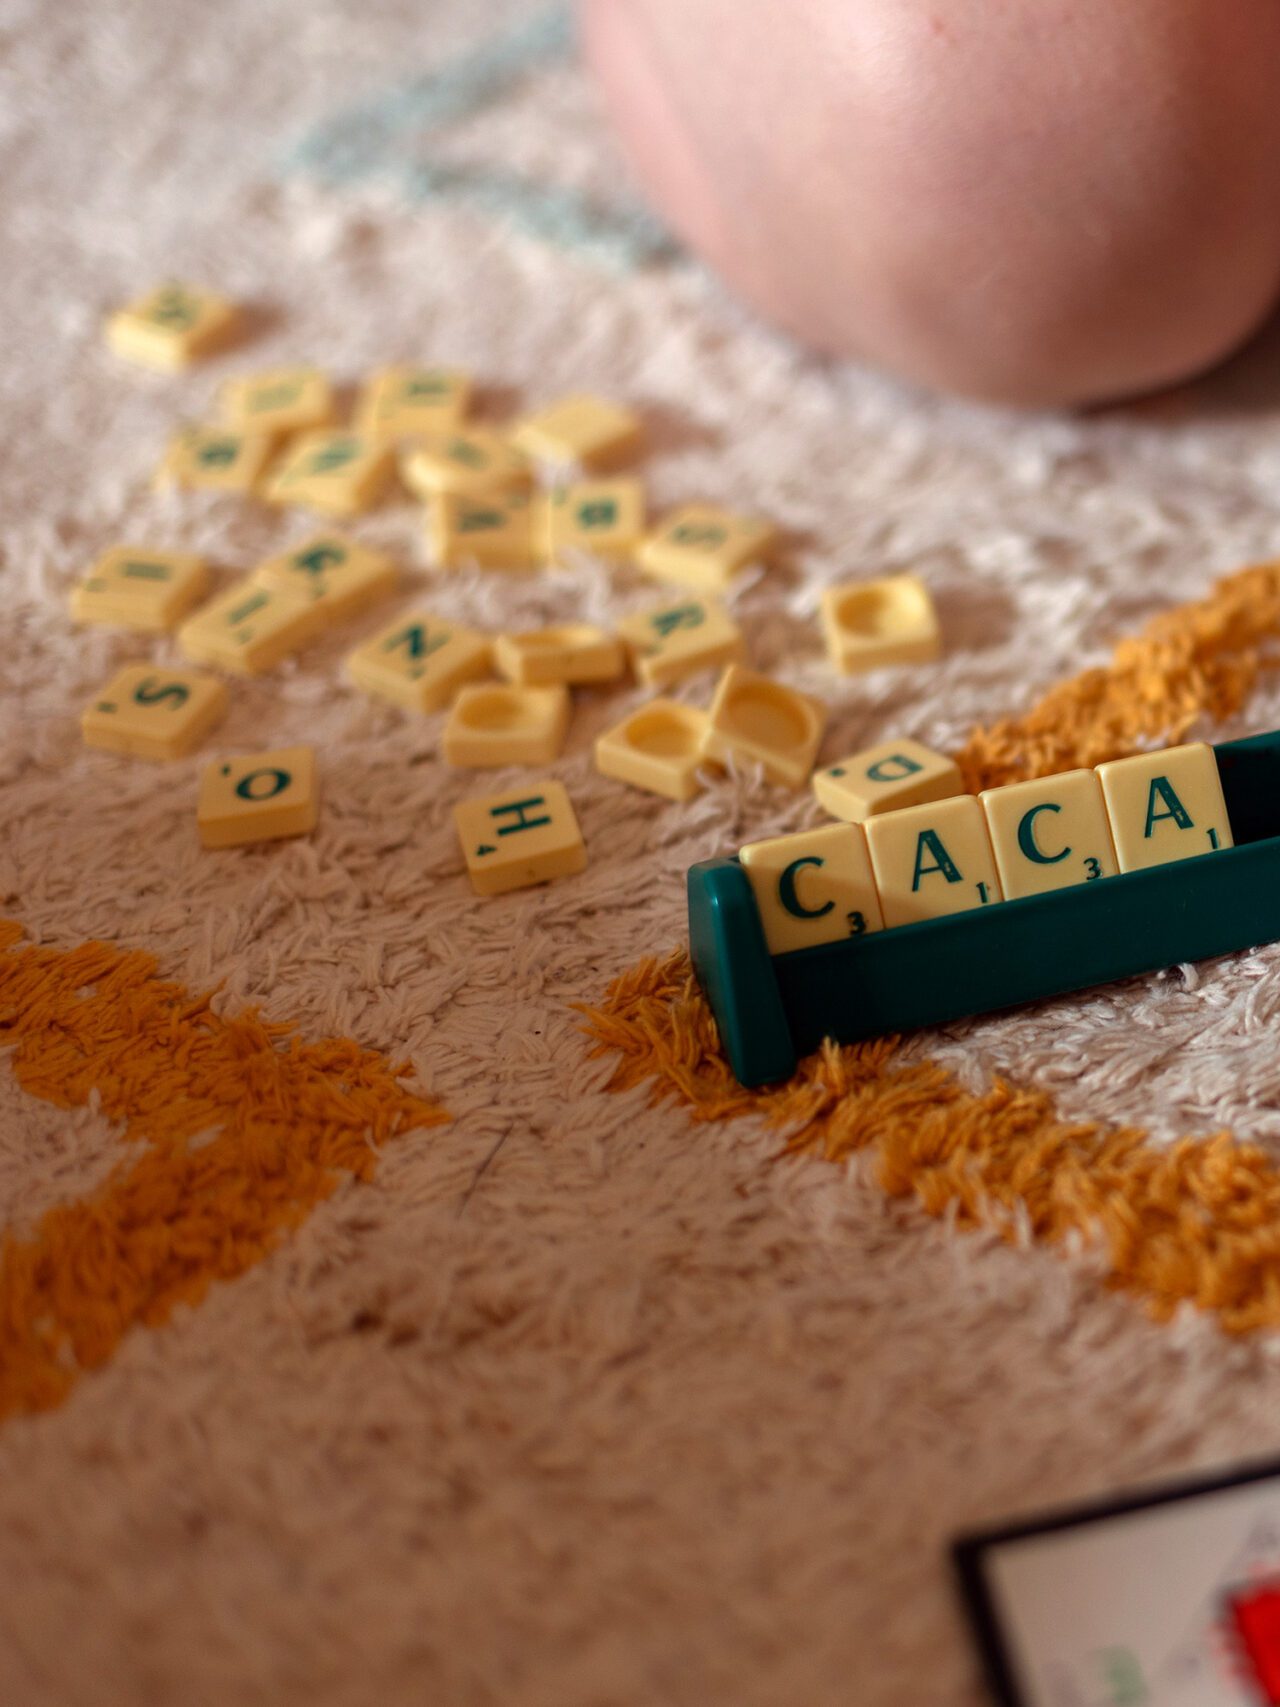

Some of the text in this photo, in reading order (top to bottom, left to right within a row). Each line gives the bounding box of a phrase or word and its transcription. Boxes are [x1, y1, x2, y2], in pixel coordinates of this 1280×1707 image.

[132, 676, 192, 712] S
[234, 768, 292, 801] O
[866, 754, 925, 782] D
[489, 796, 552, 838] H
[776, 775, 1196, 921] CACA
[847, 827, 1219, 937] 3 1 3 1
